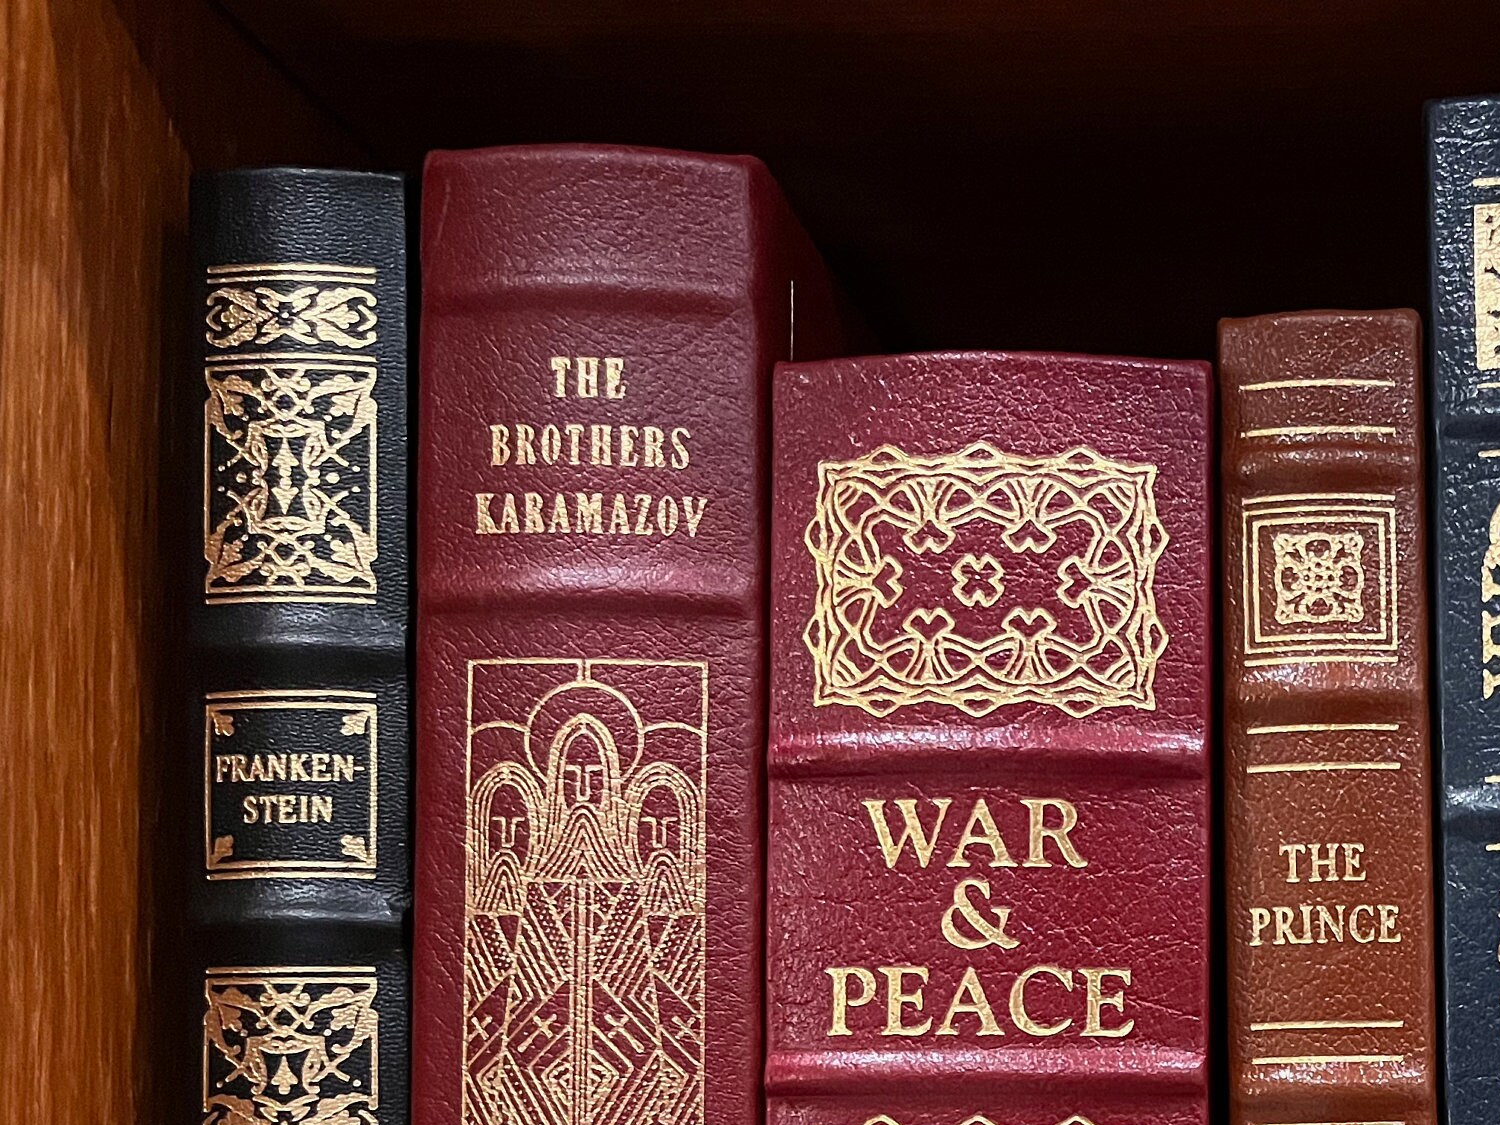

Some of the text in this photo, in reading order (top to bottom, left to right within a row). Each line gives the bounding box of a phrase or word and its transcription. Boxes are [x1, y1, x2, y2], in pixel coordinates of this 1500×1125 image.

[551, 356, 626, 400] THE
[490, 424, 691, 470] BROTHERS
[474, 492, 709, 537] KARAMAZOV
[215, 753, 366, 783] FRANKEN-
[243, 796, 333, 824] STEIN
[862, 798, 1088, 870] WAR
[1279, 842, 1367, 884] THE
[940, 878, 1020, 949] &
[1248, 904, 1402, 948] PRINCE
[824, 965, 1135, 1038] PEACE
